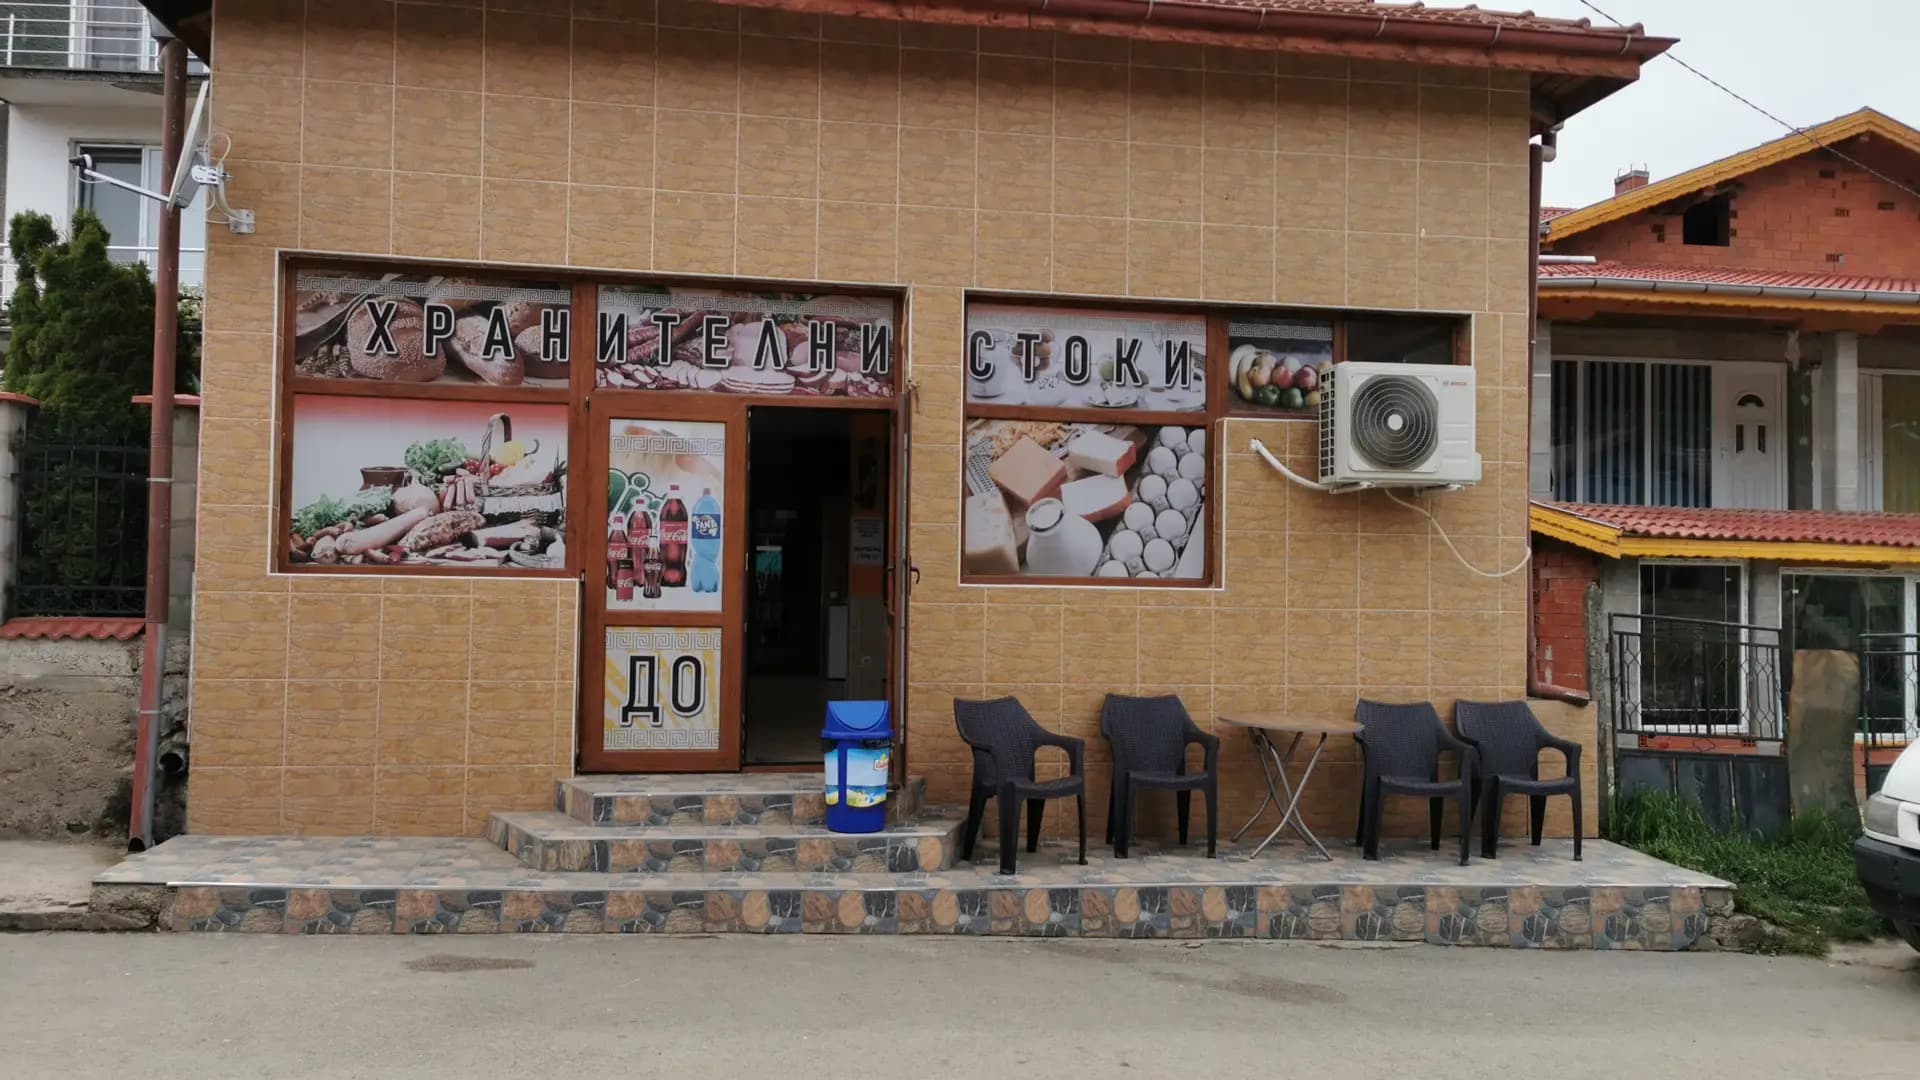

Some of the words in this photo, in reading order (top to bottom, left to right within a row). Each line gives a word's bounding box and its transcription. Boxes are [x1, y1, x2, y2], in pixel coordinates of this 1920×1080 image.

[364, 299, 890, 376] ХРАНИТЕЛНИ
[967, 329, 1193, 389] СТОКИ
[620, 654, 706, 728] ДО
